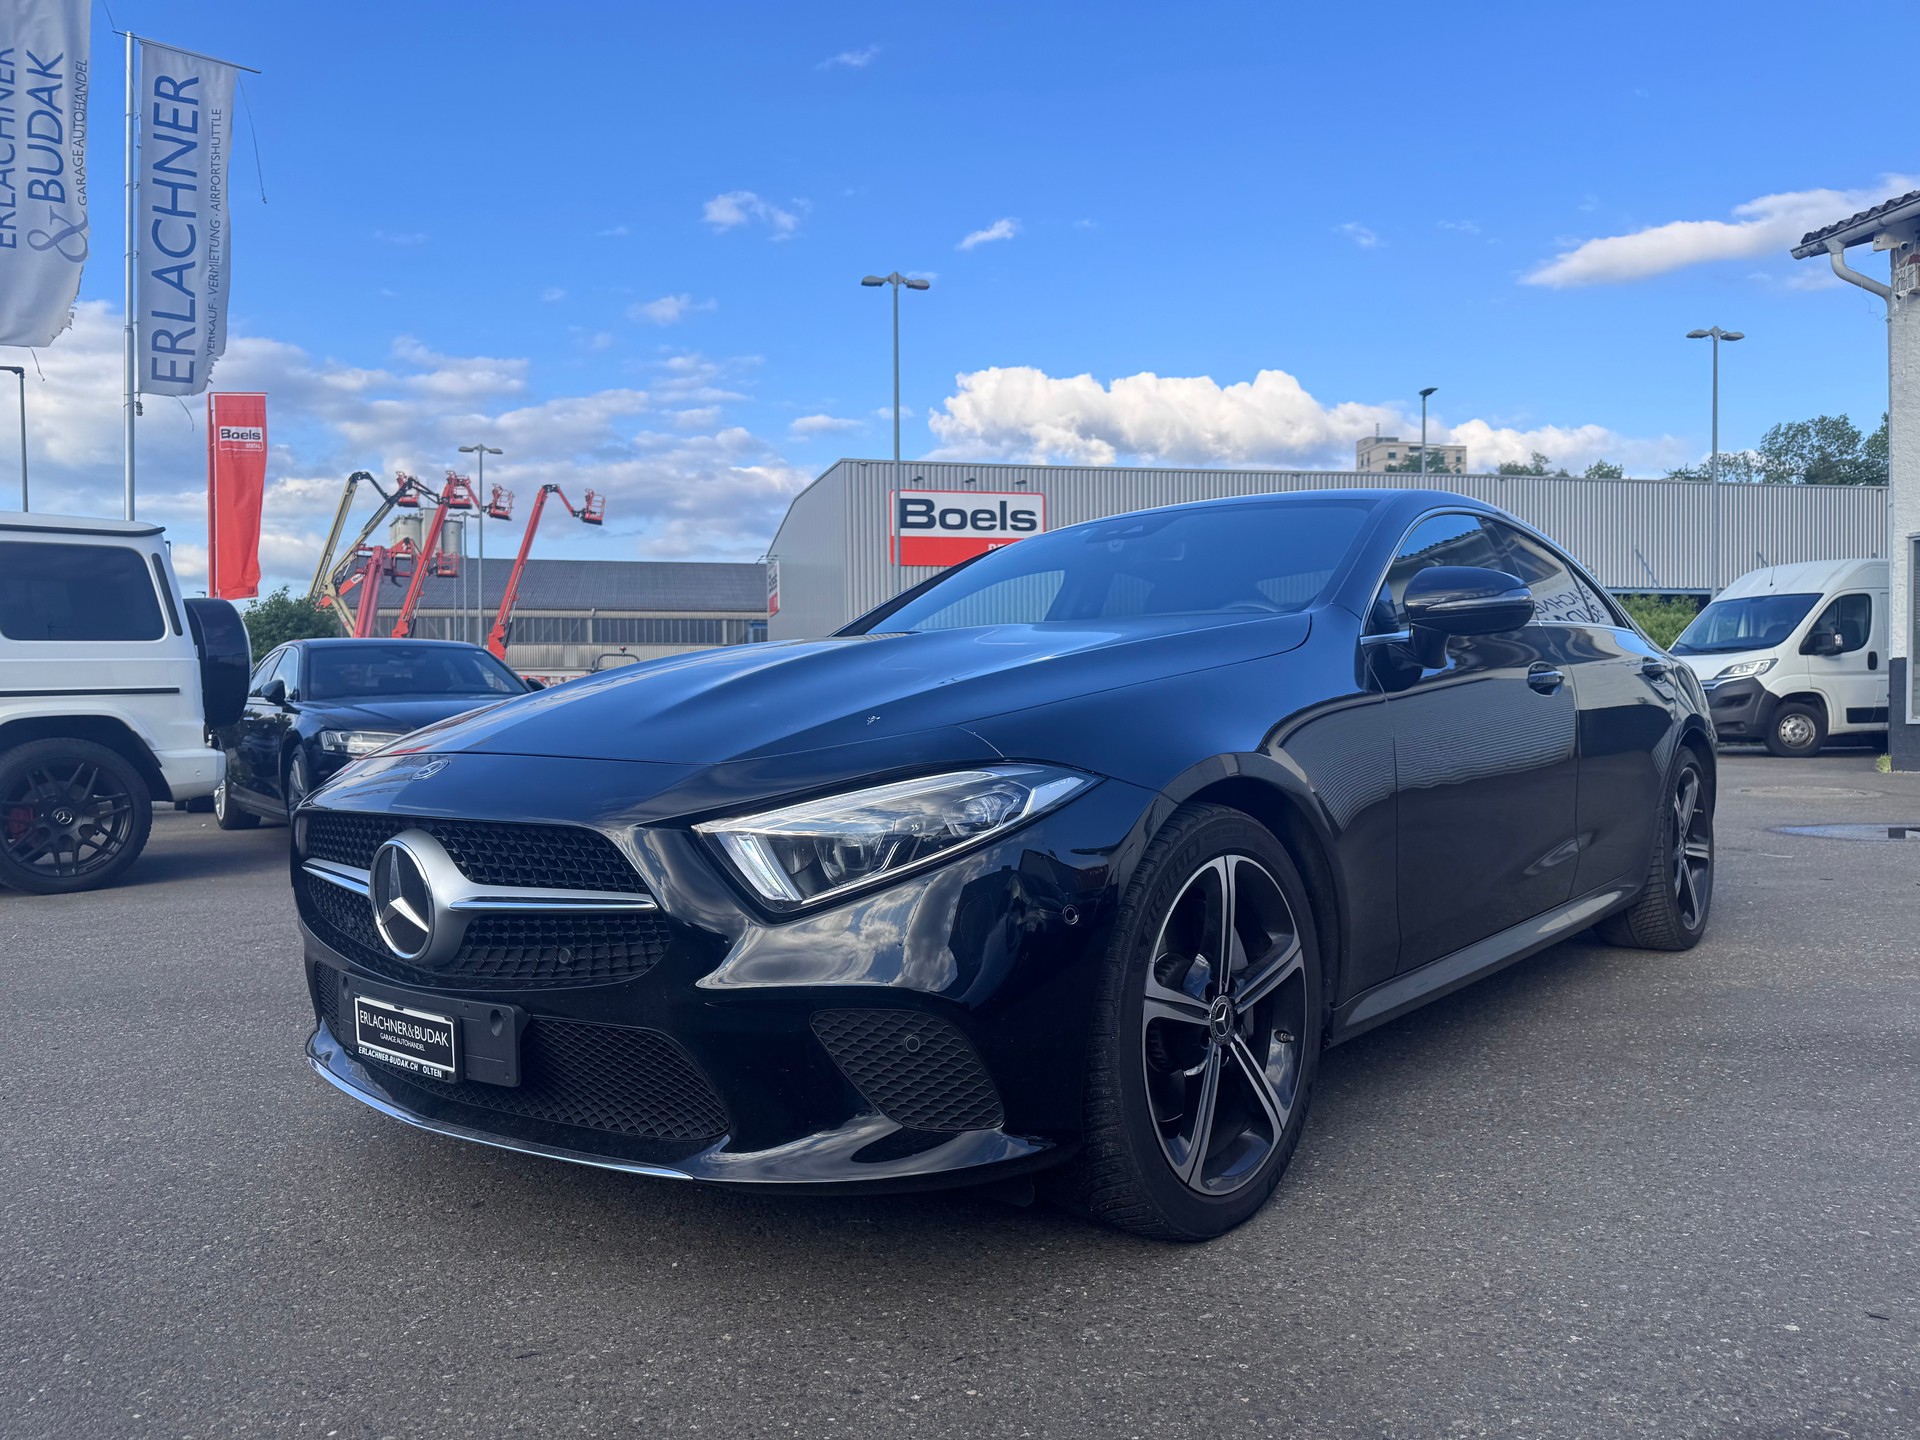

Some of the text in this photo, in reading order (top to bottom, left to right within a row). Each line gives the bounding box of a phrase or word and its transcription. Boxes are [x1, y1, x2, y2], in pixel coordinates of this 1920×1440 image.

[26, 49, 89, 264] & BUDAK
[71, 59, 88, 206] GARAGE AUTOHANDEL
[151, 75, 200, 384] ERLACHNER
[206, 108, 222, 357] VERKAUF VERMIETUNG AIRPORTSHUTTLE
[221, 428, 261, 440] Boels
[899, 498, 1038, 532] Boels
[1141, 839, 1202, 941] MICHELIN
[358, 1046, 442, 1078] ERLACHNER-BUDAK.CH OLTEN
[380, 1032, 426, 1052] GARAGE AUTOHANDEL
